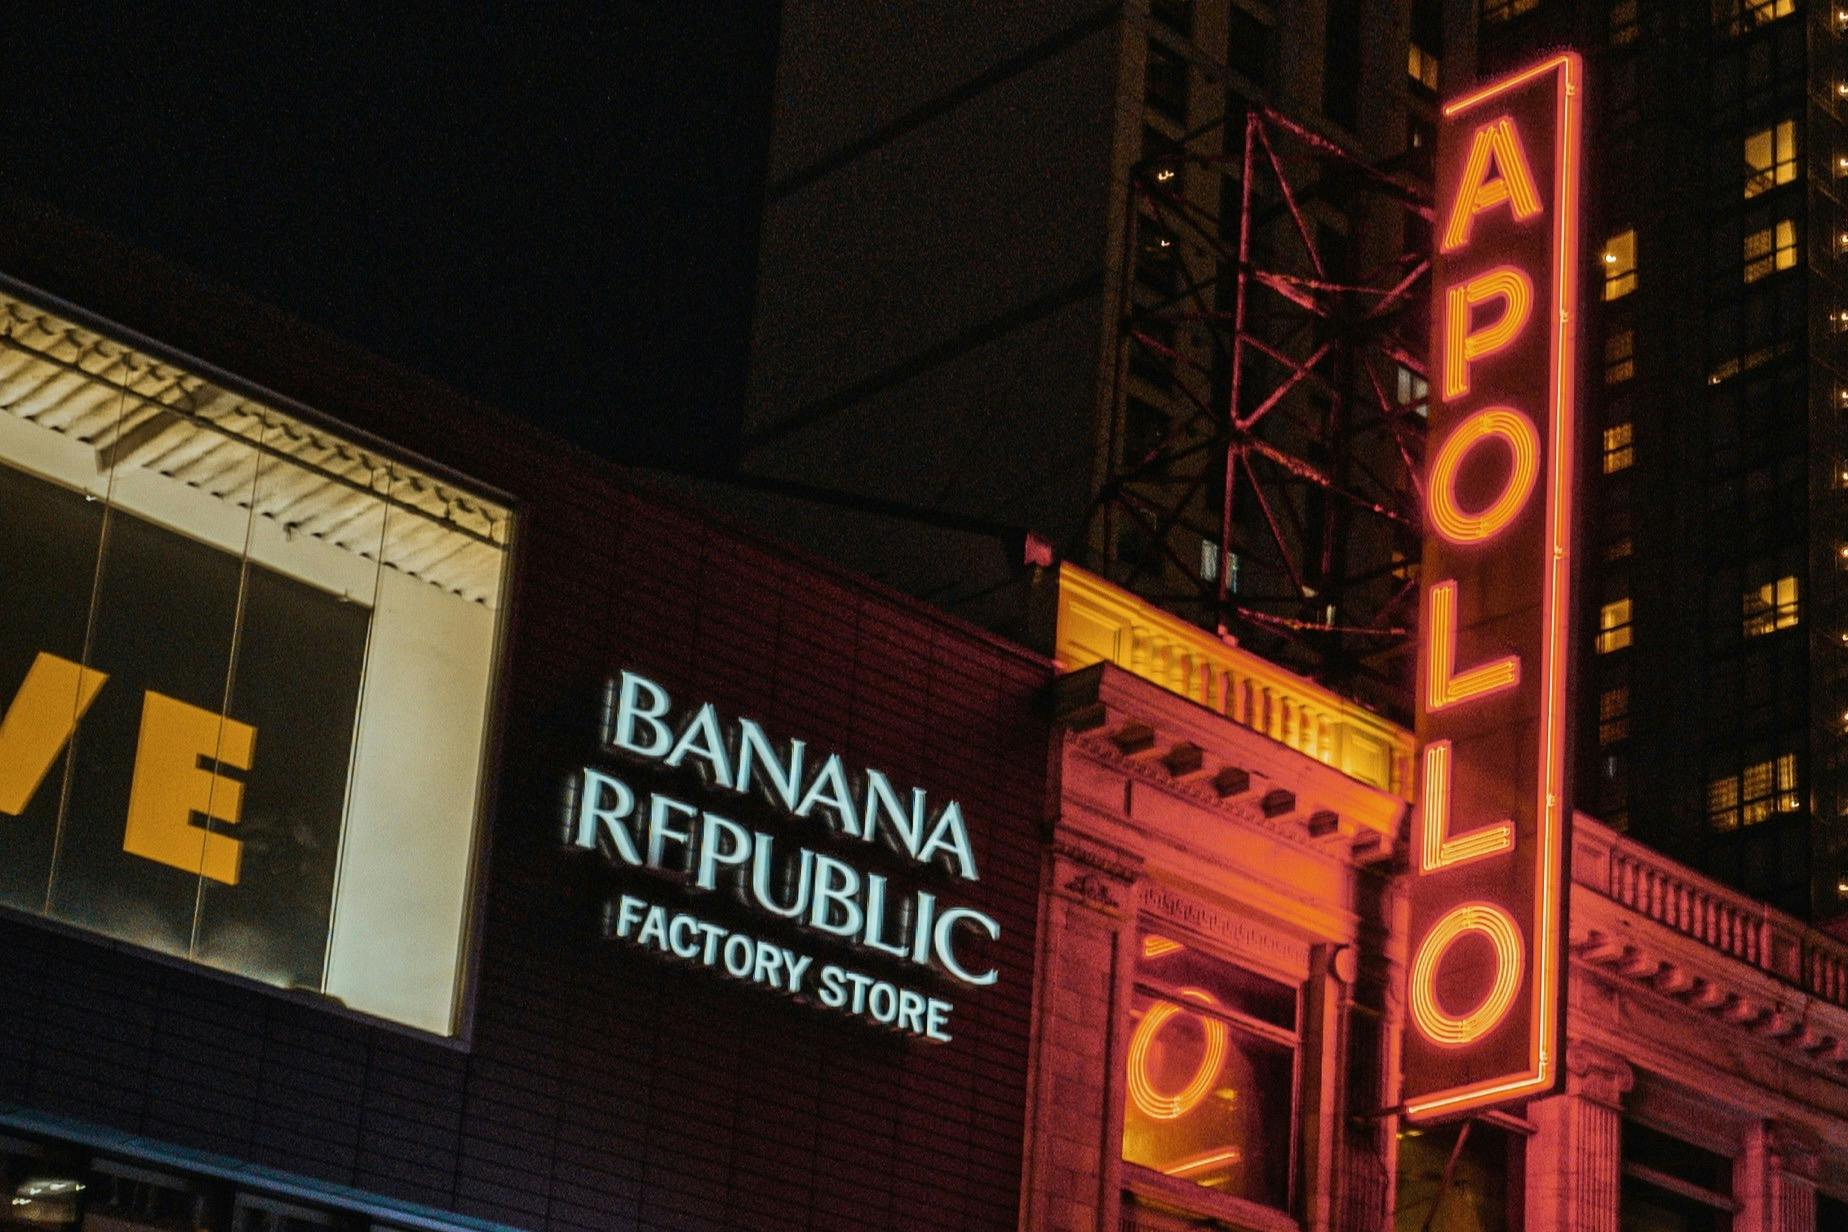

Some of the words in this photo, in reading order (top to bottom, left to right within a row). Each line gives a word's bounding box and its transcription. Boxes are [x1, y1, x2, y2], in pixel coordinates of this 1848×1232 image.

[1407, 115, 1543, 1050] APOLLO
[610, 670, 981, 881] BANANA
[615, 895, 812, 996] FACTORY
[818, 965, 954, 1044] STORE
